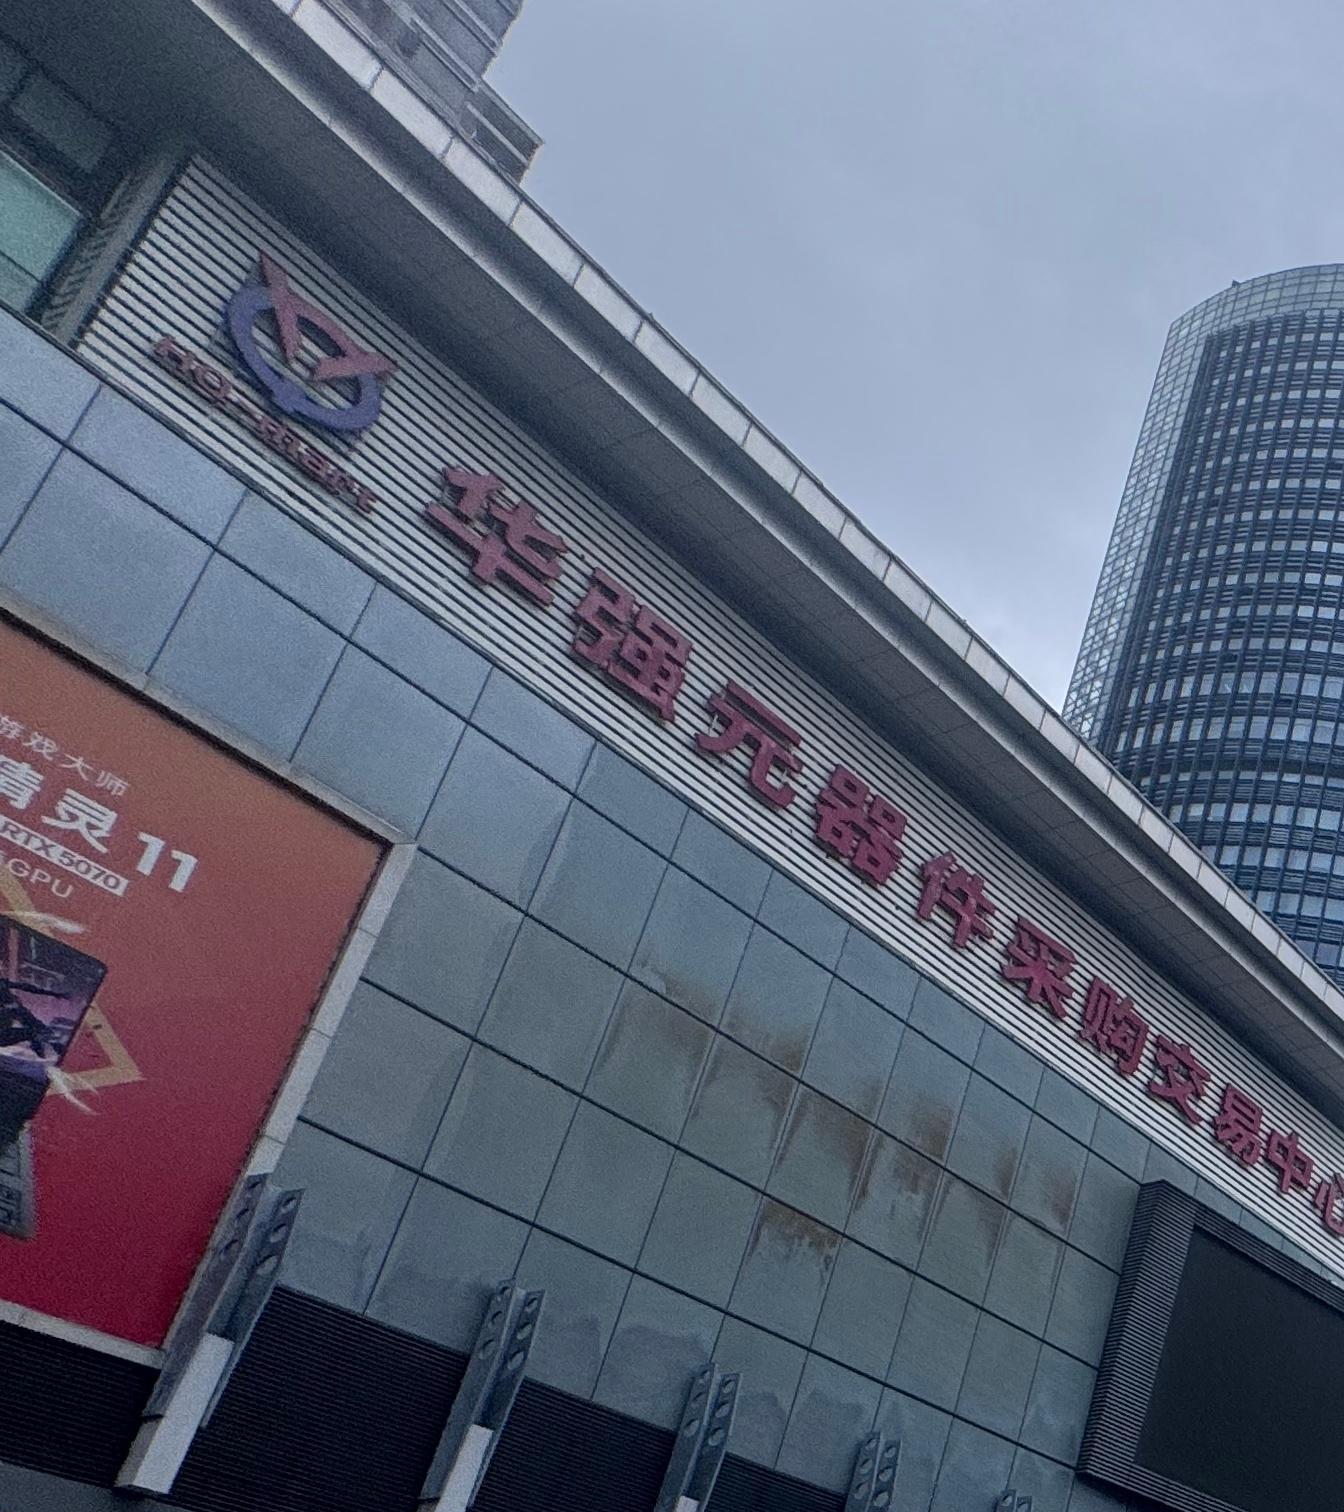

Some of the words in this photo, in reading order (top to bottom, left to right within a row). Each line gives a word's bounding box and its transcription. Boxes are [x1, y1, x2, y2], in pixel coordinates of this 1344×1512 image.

[1, 820, 56, 858] RTX
[58, 851, 121, 889] 5070
[8, 858, 73, 898] GPU
